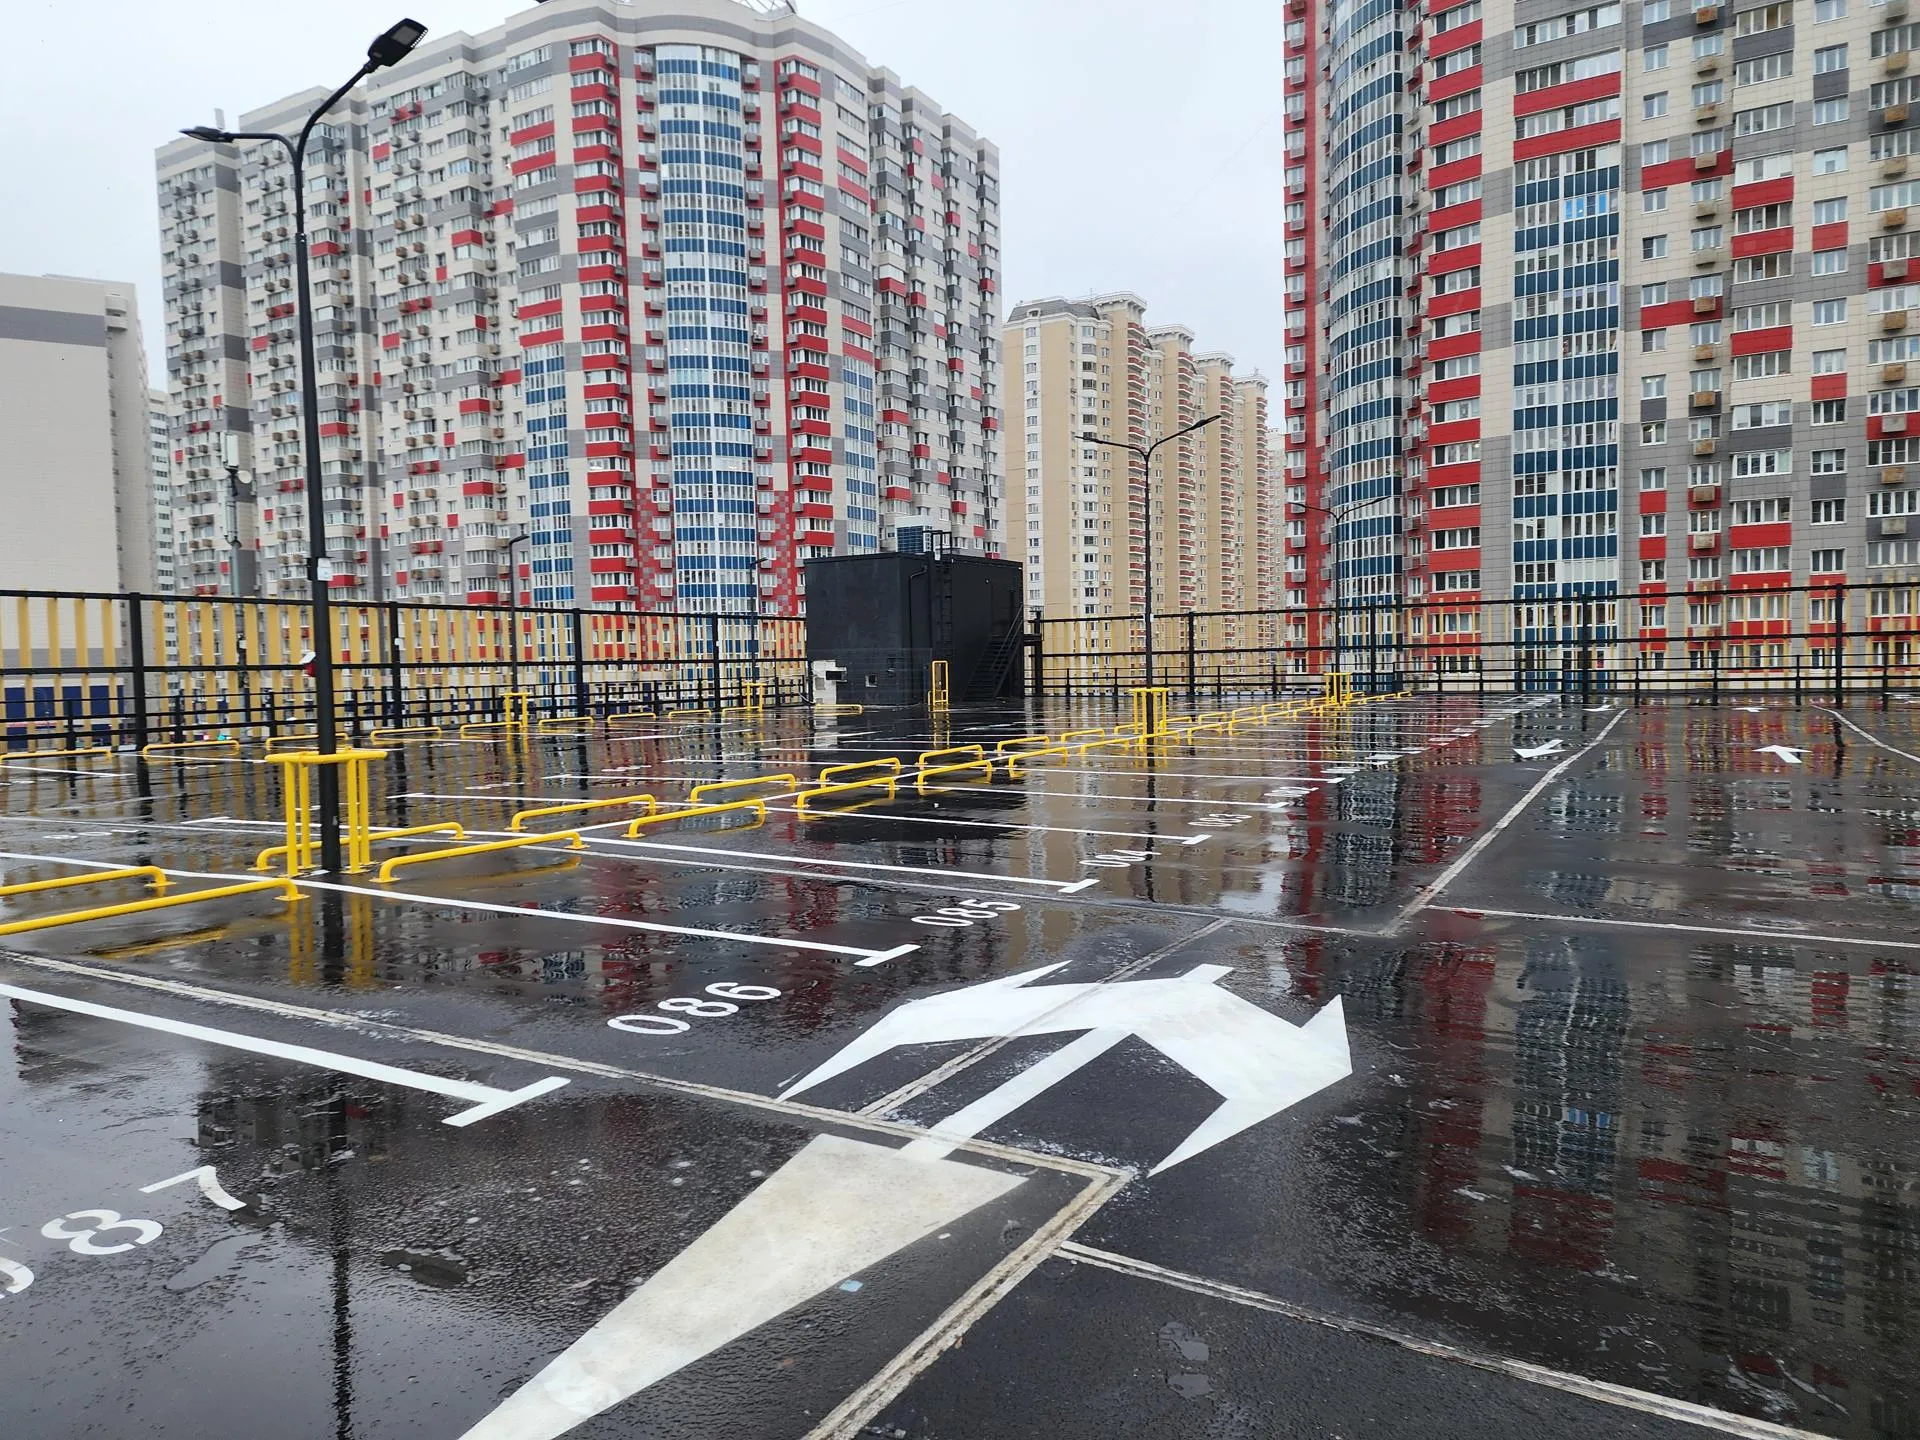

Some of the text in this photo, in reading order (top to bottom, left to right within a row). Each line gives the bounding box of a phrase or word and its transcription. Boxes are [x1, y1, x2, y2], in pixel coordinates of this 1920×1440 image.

[1187, 813, 1253, 827] 083
[1078, 849, 1162, 868] 084
[911, 898, 1022, 928] 085
[606, 981, 782, 1036] 086
